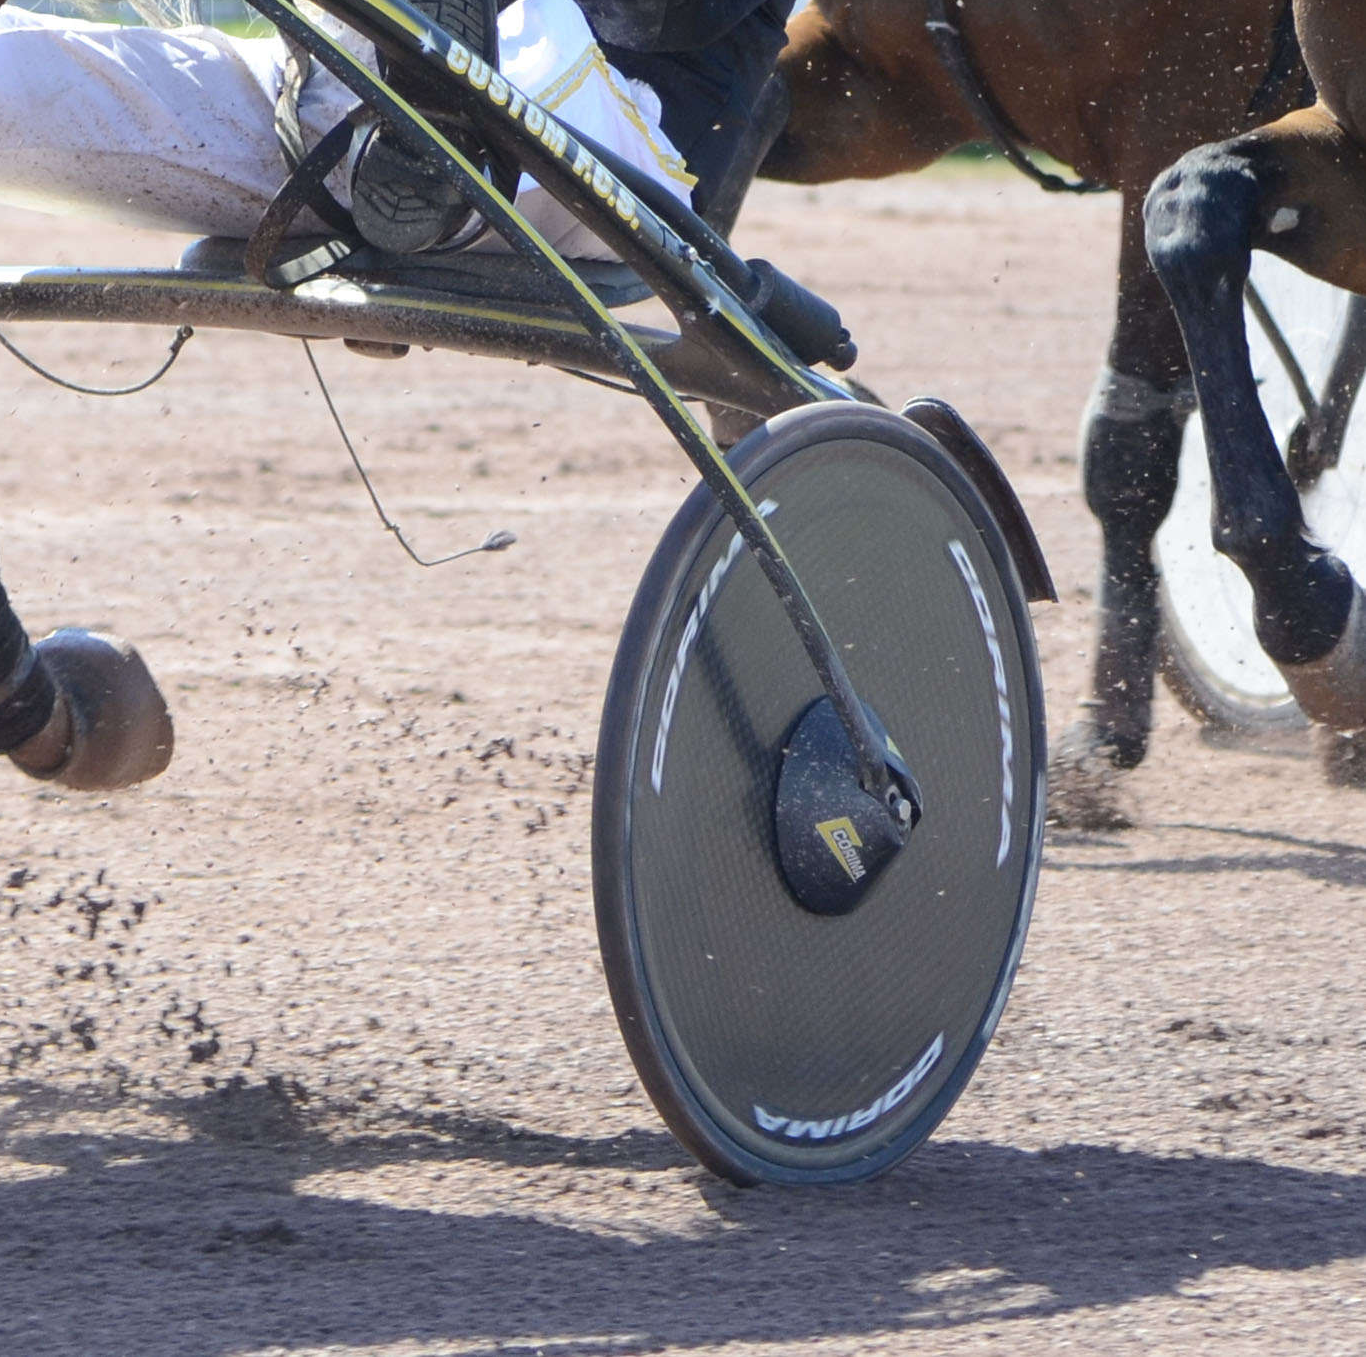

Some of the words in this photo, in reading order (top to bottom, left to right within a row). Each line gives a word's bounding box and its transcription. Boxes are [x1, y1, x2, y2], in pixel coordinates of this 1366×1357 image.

[446, 39, 569, 160] CUSTOM
[948, 539, 1013, 869] CORIMA
[833, 829, 867, 880] CORIMA
[753, 1030, 944, 1139] CORIMA
